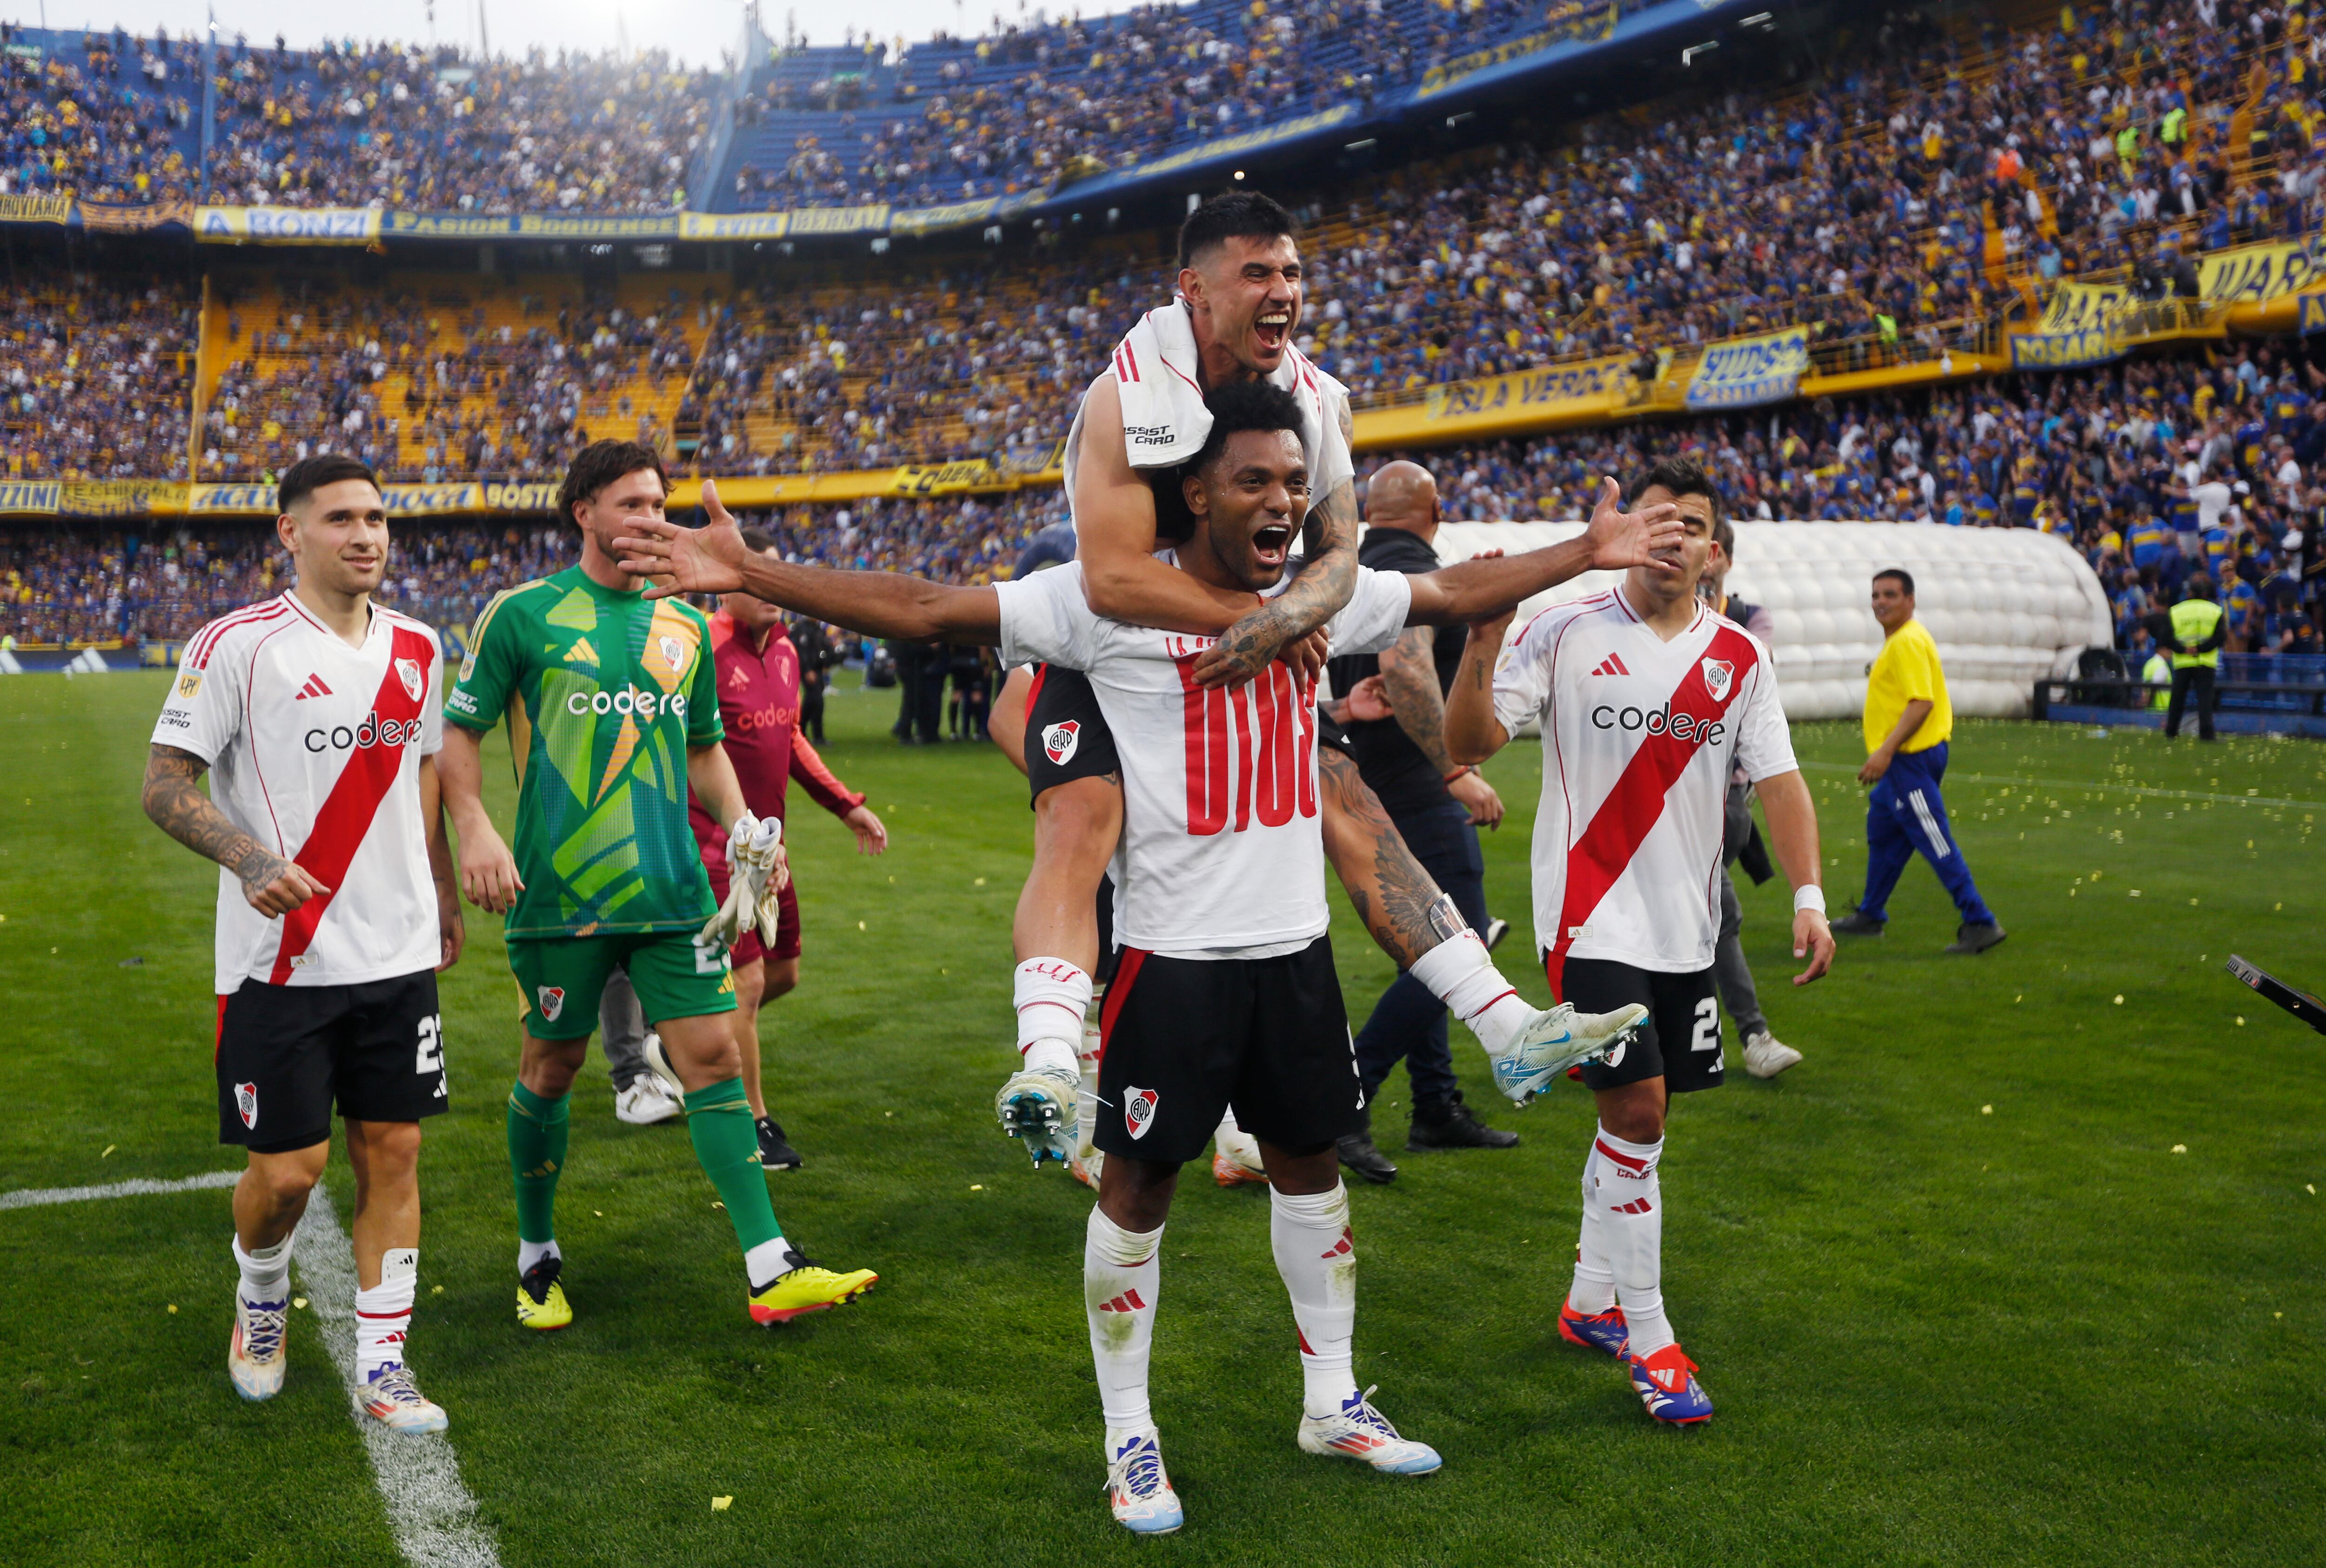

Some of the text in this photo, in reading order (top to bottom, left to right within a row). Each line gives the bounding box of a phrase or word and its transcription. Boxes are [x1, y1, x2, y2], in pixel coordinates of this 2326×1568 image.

[203, 209, 368, 237] A BONZI
[1124, 425, 1170, 436] SSIST
[1135, 434, 1175, 445] CARD
[1709, 667, 1727, 687] CARP
[567, 682, 686, 717] codere
[737, 702, 795, 730] coder
[1591, 701, 1725, 746] codere
[305, 710, 422, 755] codere
[1049, 730, 1072, 750] CARP
[1130, 1098, 1150, 1122] CARP
